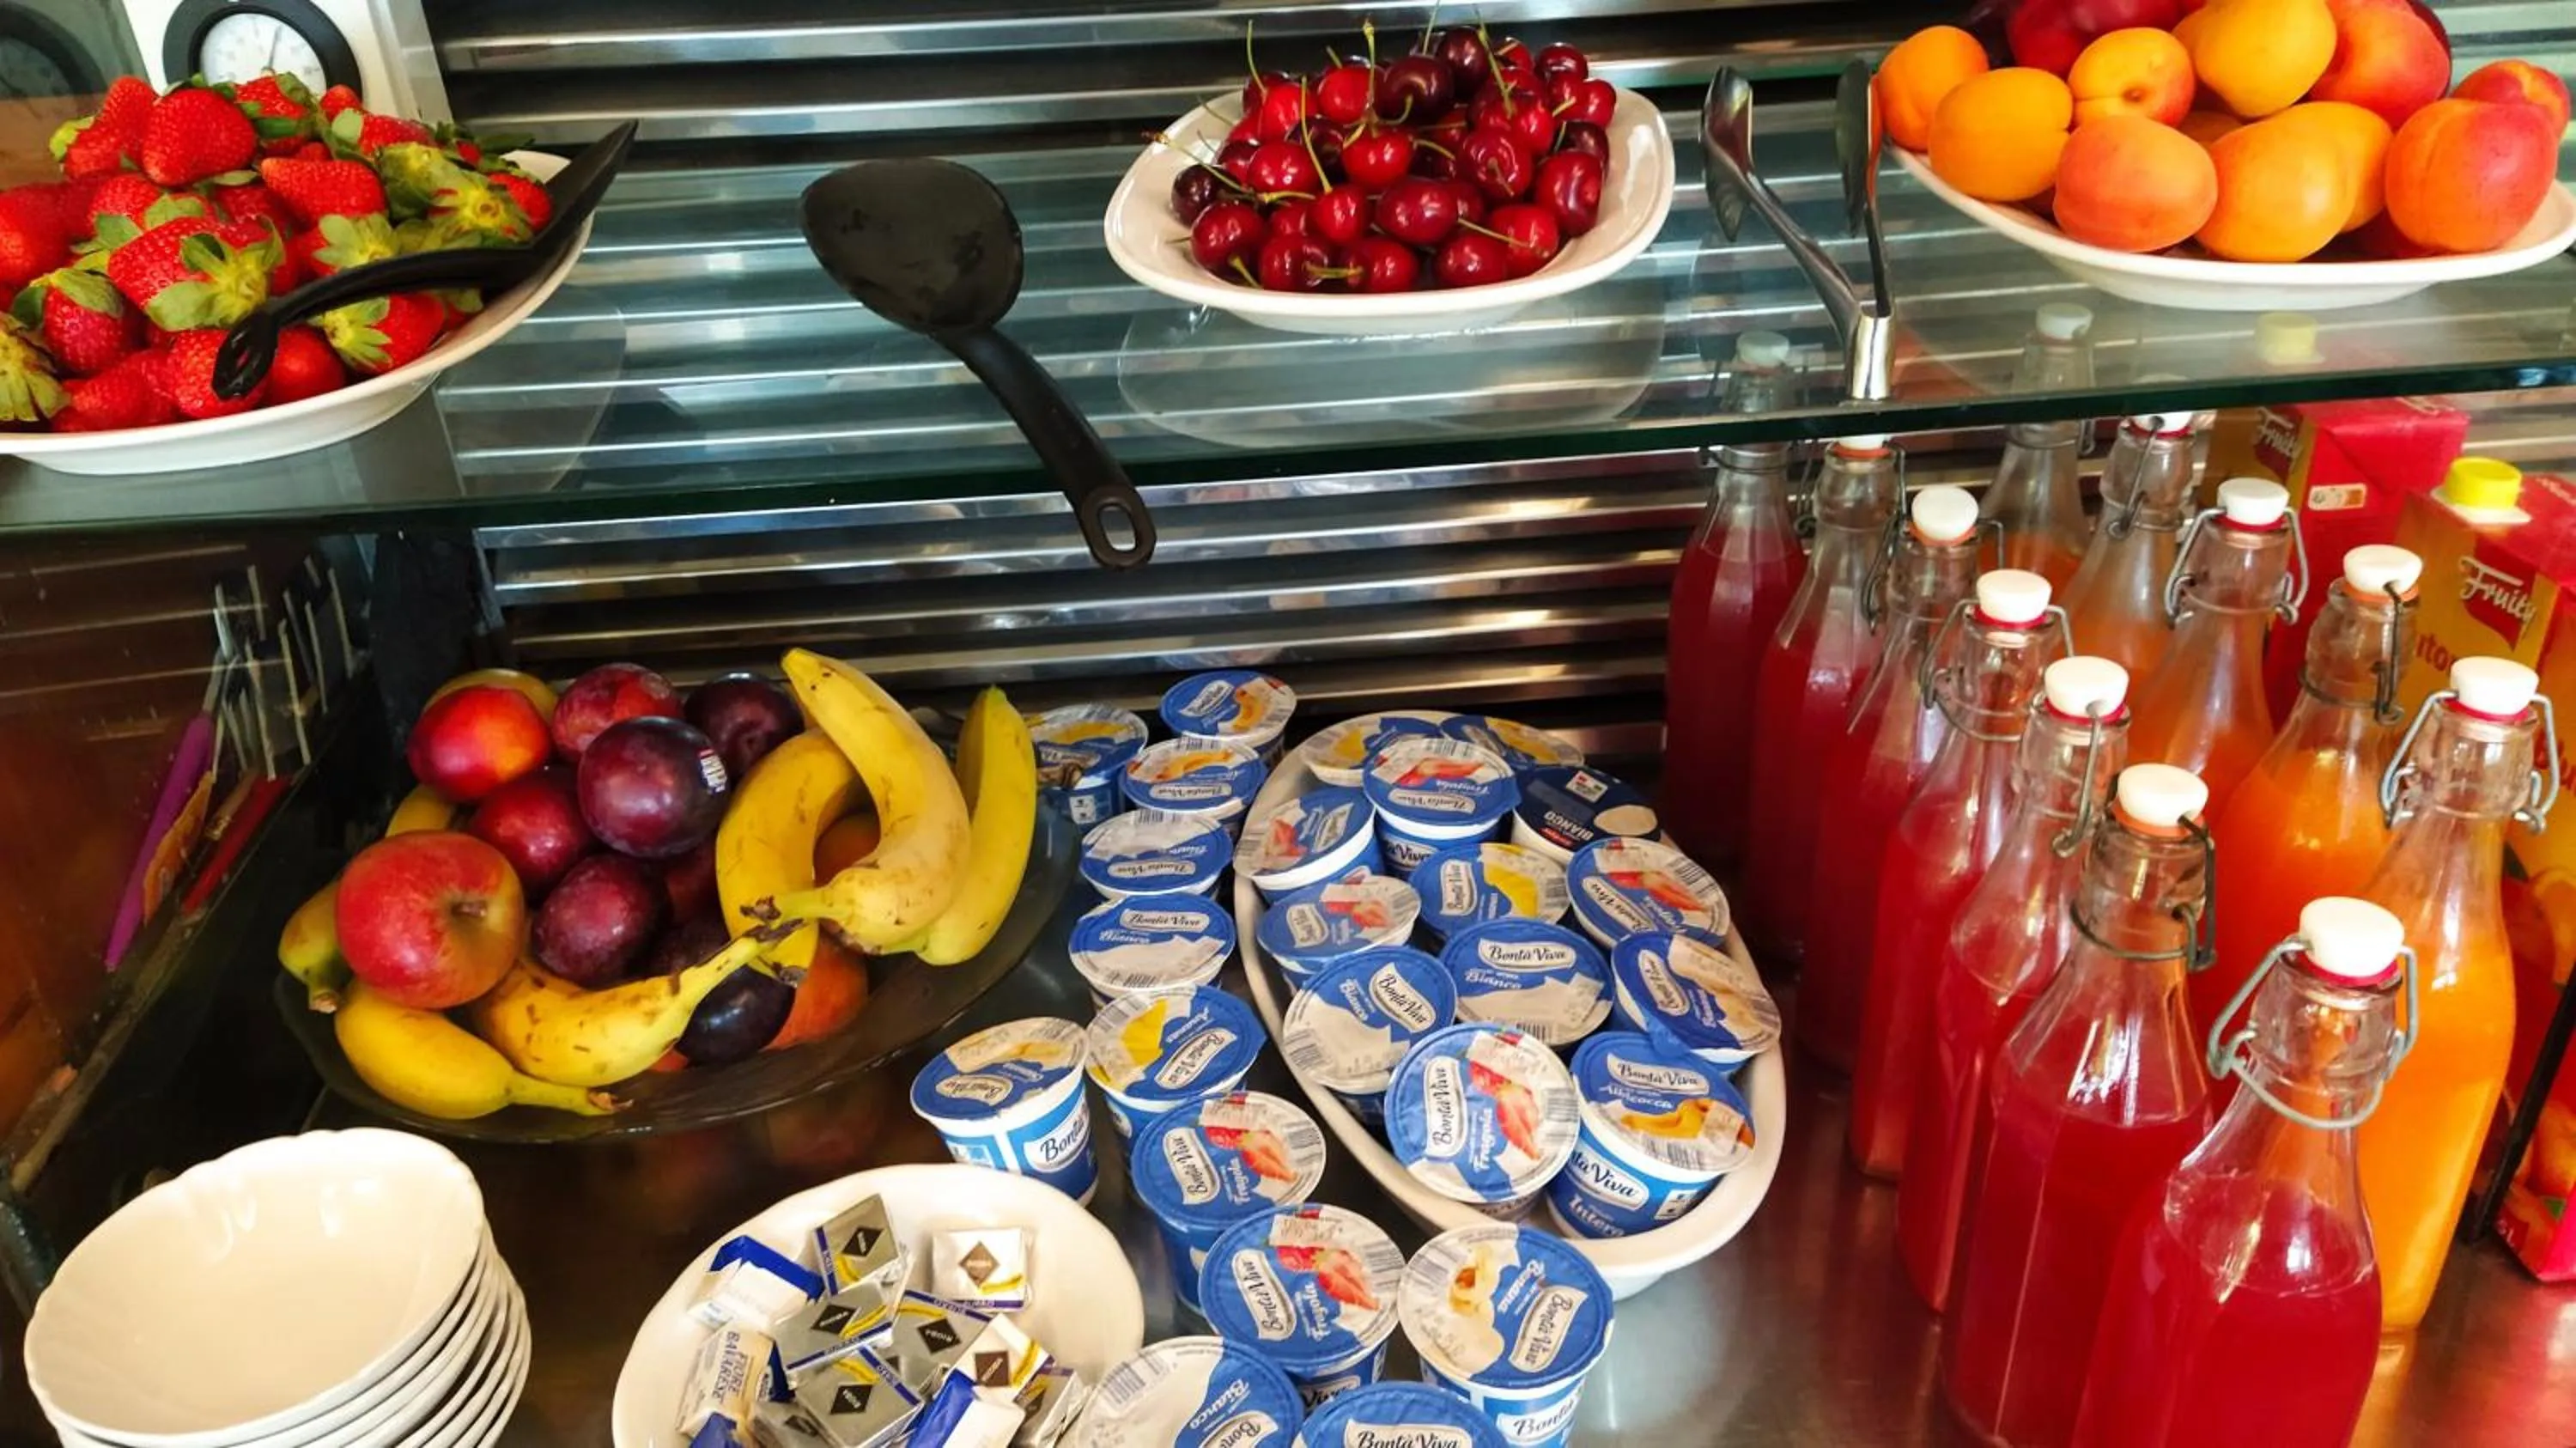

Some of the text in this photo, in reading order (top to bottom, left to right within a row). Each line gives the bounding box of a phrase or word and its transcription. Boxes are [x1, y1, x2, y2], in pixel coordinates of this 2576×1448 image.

[2257, 406, 2305, 464] Fruity
[2459, 555, 2537, 636] Fruity
[1543, 811, 1595, 841] BIANCO
[1473, 1107, 1497, 1173] Fragola
[1590, 1162, 1639, 1197] Viva
[1304, 1281, 1331, 1342] Fragola
[1189, 1379, 1250, 1430] Bianco
[1218, 1421, 1261, 1448] Bon
[1415, 1432, 1459, 1448] Viva
